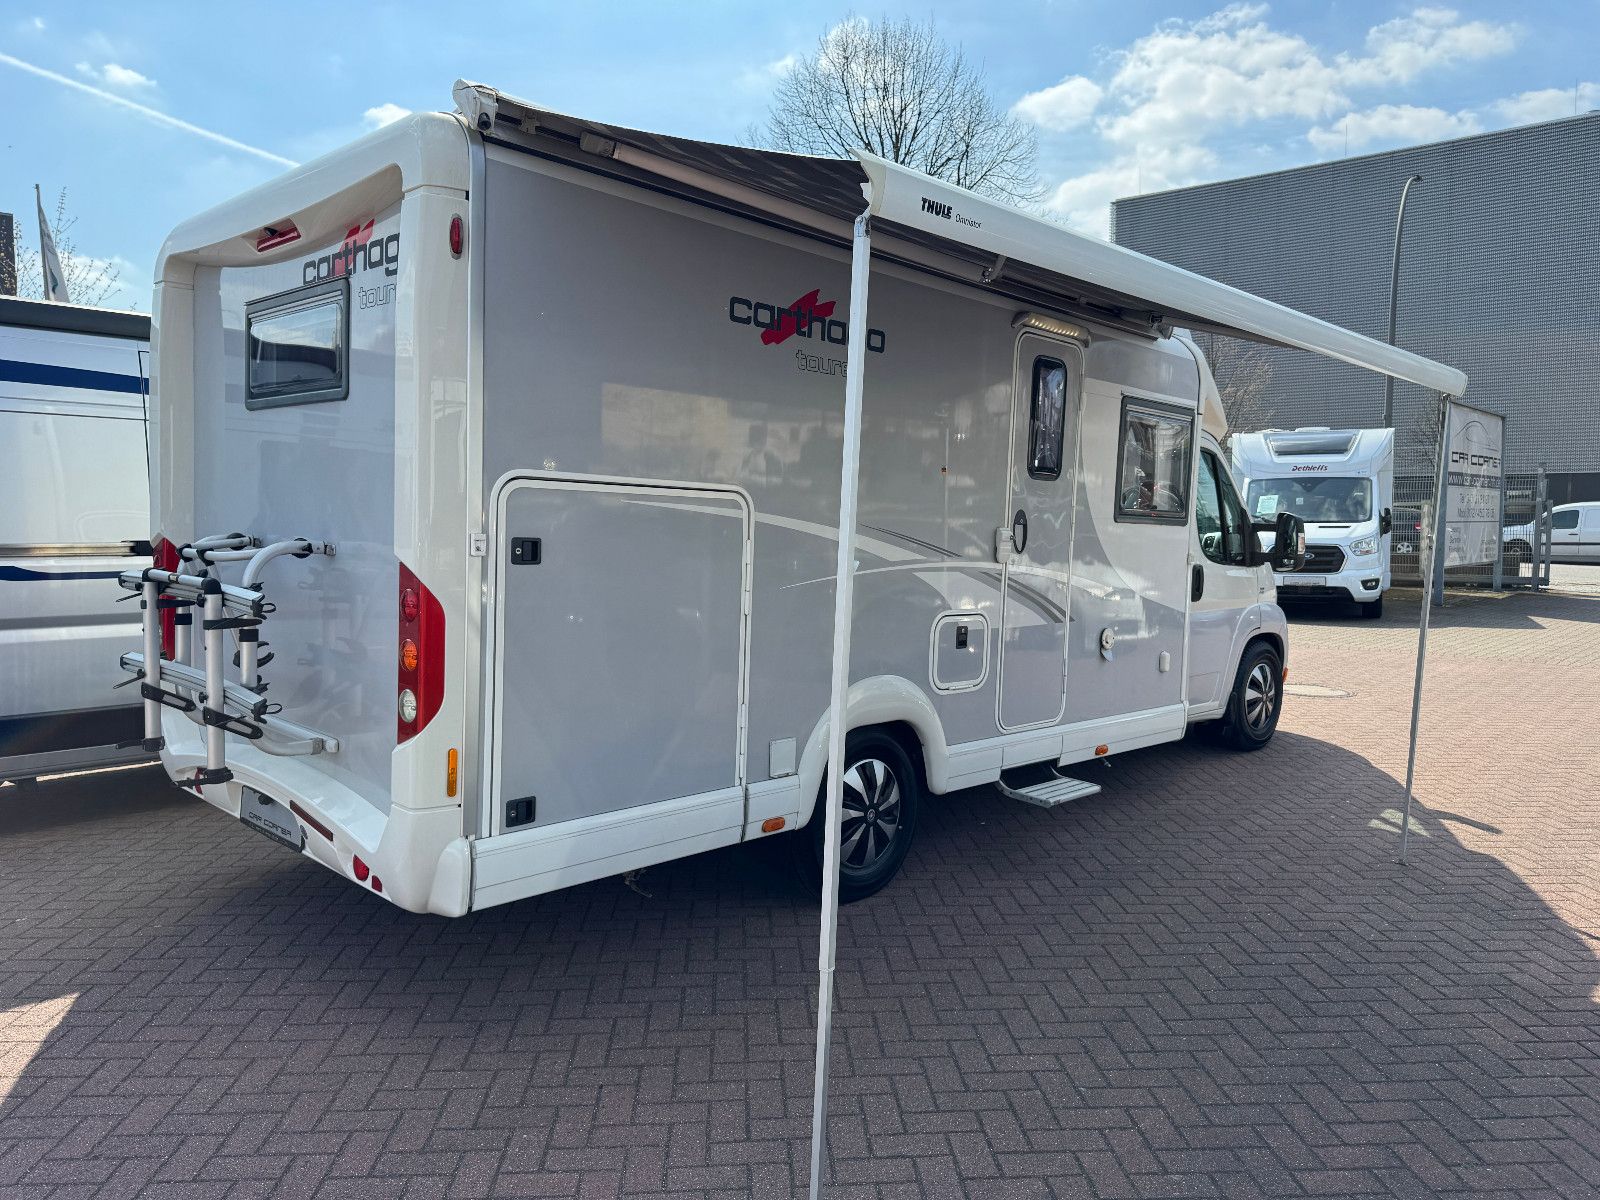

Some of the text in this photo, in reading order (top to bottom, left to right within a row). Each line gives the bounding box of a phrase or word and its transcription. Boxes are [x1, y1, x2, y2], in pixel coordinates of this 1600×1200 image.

[921, 196, 953, 218] THULE
[729, 296, 886, 353] carthao
[1291, 464, 1329, 472] Dethleffs
